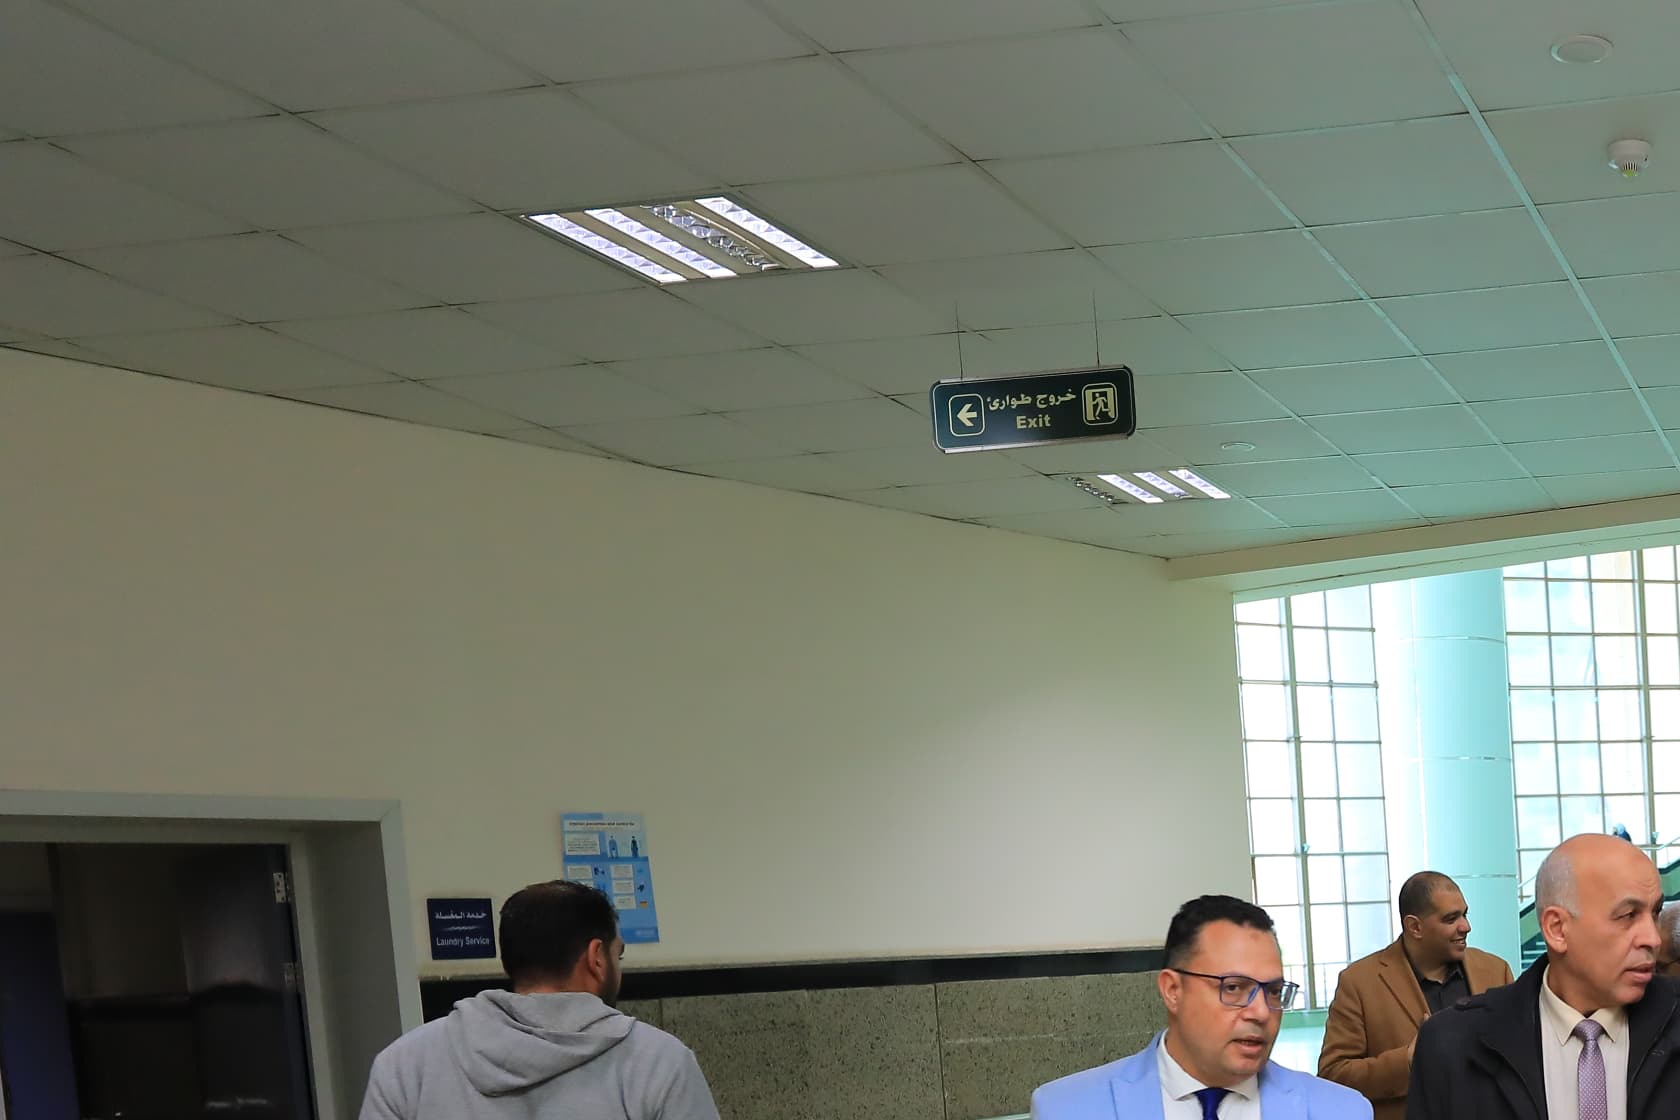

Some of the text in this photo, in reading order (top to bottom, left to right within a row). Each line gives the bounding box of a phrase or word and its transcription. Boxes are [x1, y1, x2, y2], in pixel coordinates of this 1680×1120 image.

[1036, 388, 1077, 409] خروج
[1016, 414, 1051, 429] Exit
[436, 936, 490, 948] Laundry Service
